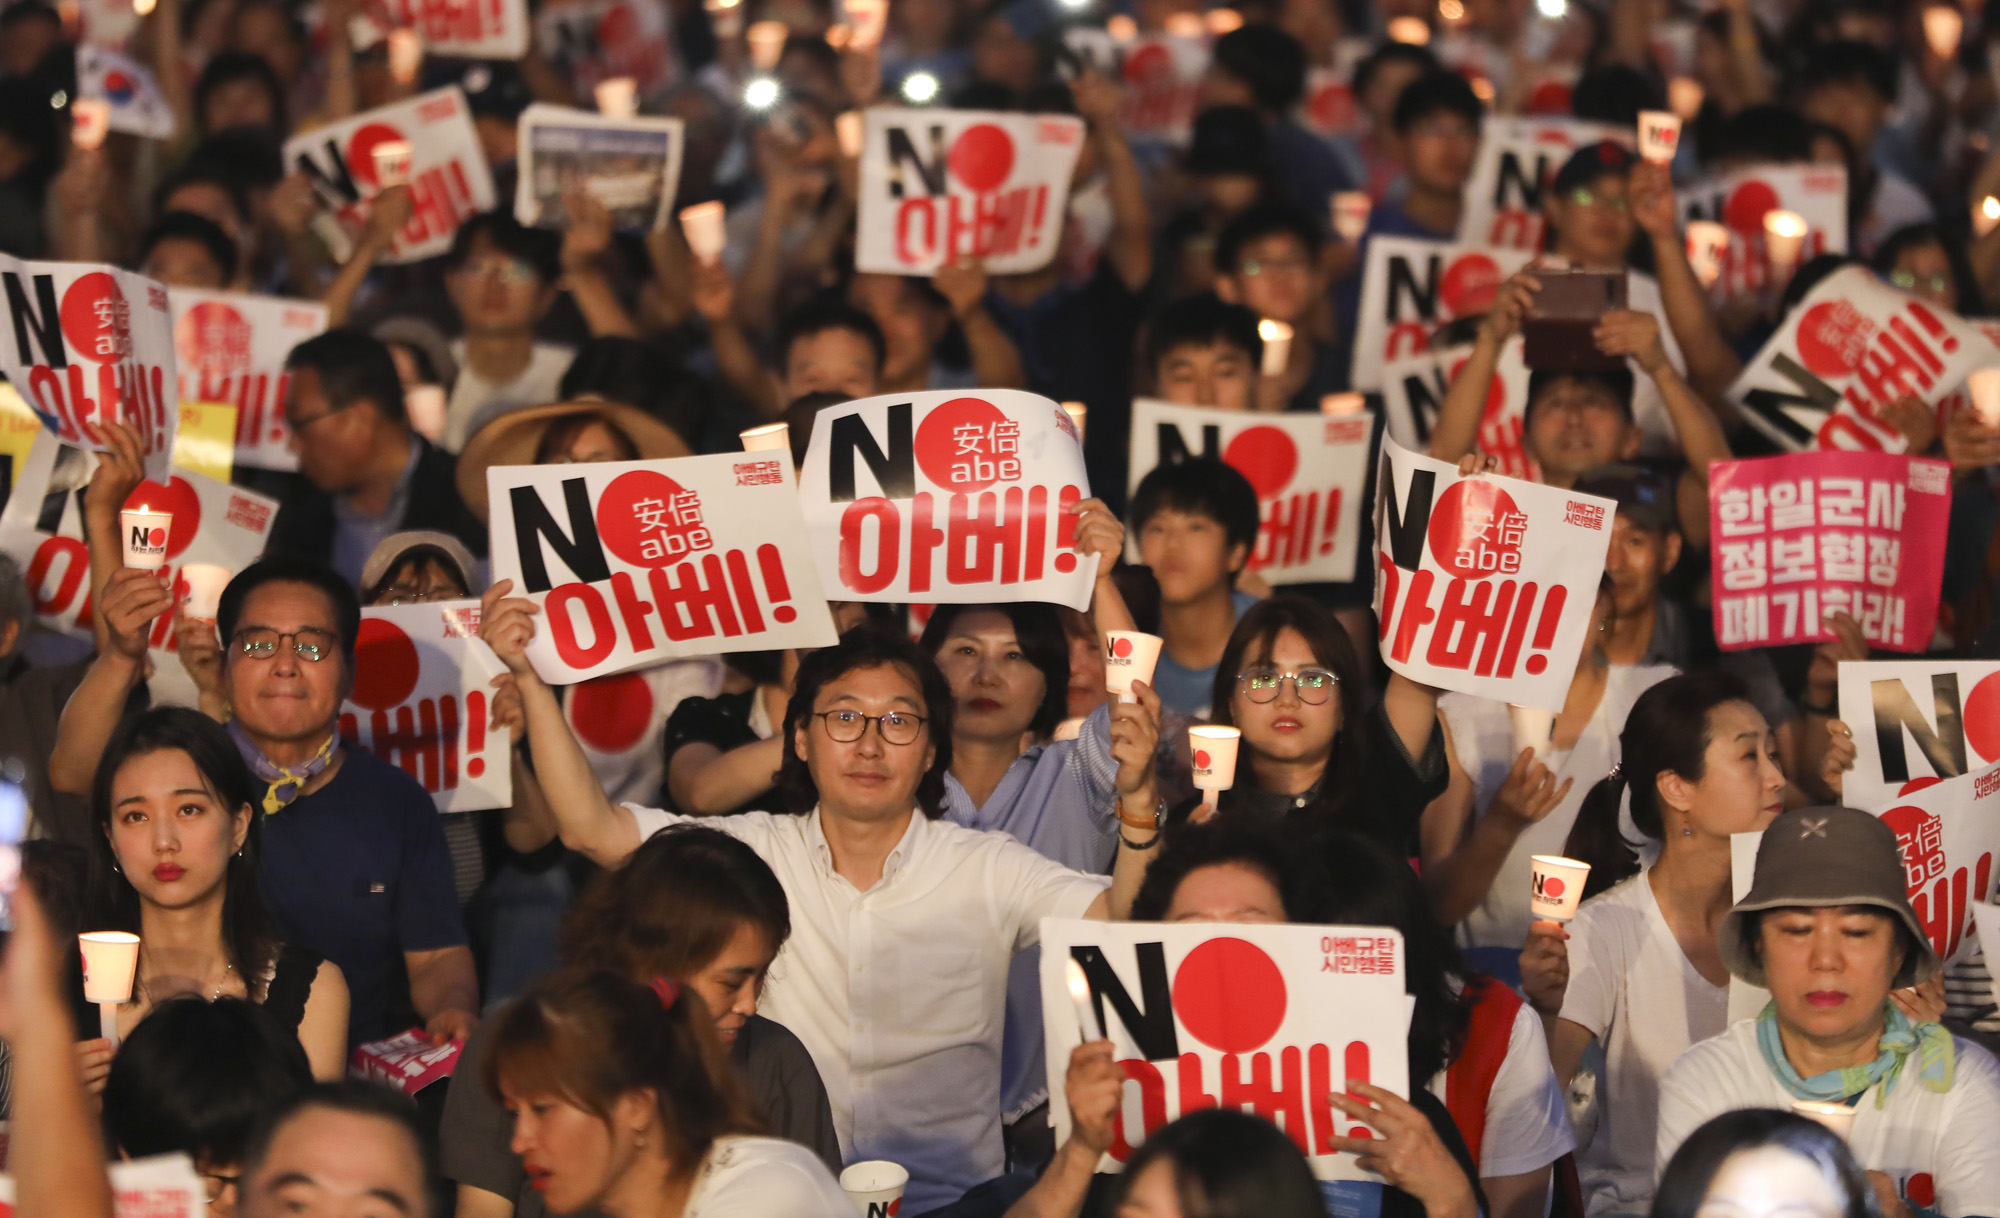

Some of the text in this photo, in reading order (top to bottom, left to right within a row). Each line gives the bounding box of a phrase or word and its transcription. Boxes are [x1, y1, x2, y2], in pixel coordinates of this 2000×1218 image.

[952, 420, 1021, 456] 安倍
[951, 455, 1022, 484] abe
[632, 489, 703, 532] 安倍
[1563, 513, 1603, 531] 시민행동
[1566, 500, 1605, 518] 아베규탄
[1719, 479, 1906, 537] 한일군사
[639, 526, 713, 560] abe
[839, 484, 1081, 595] 아베!
[1461, 510, 1528, 547] 安倍
[1454, 543, 1522, 575] abe
[1719, 533, 1900, 591] 정보협정
[544, 543, 797, 670] 아베!
[1720, 588, 1906, 645] 폐기하라!
[1906, 851, 1946, 888] be
[1321, 937, 1395, 956] 아베규탄
[1321, 955, 1394, 975] 시민행동
